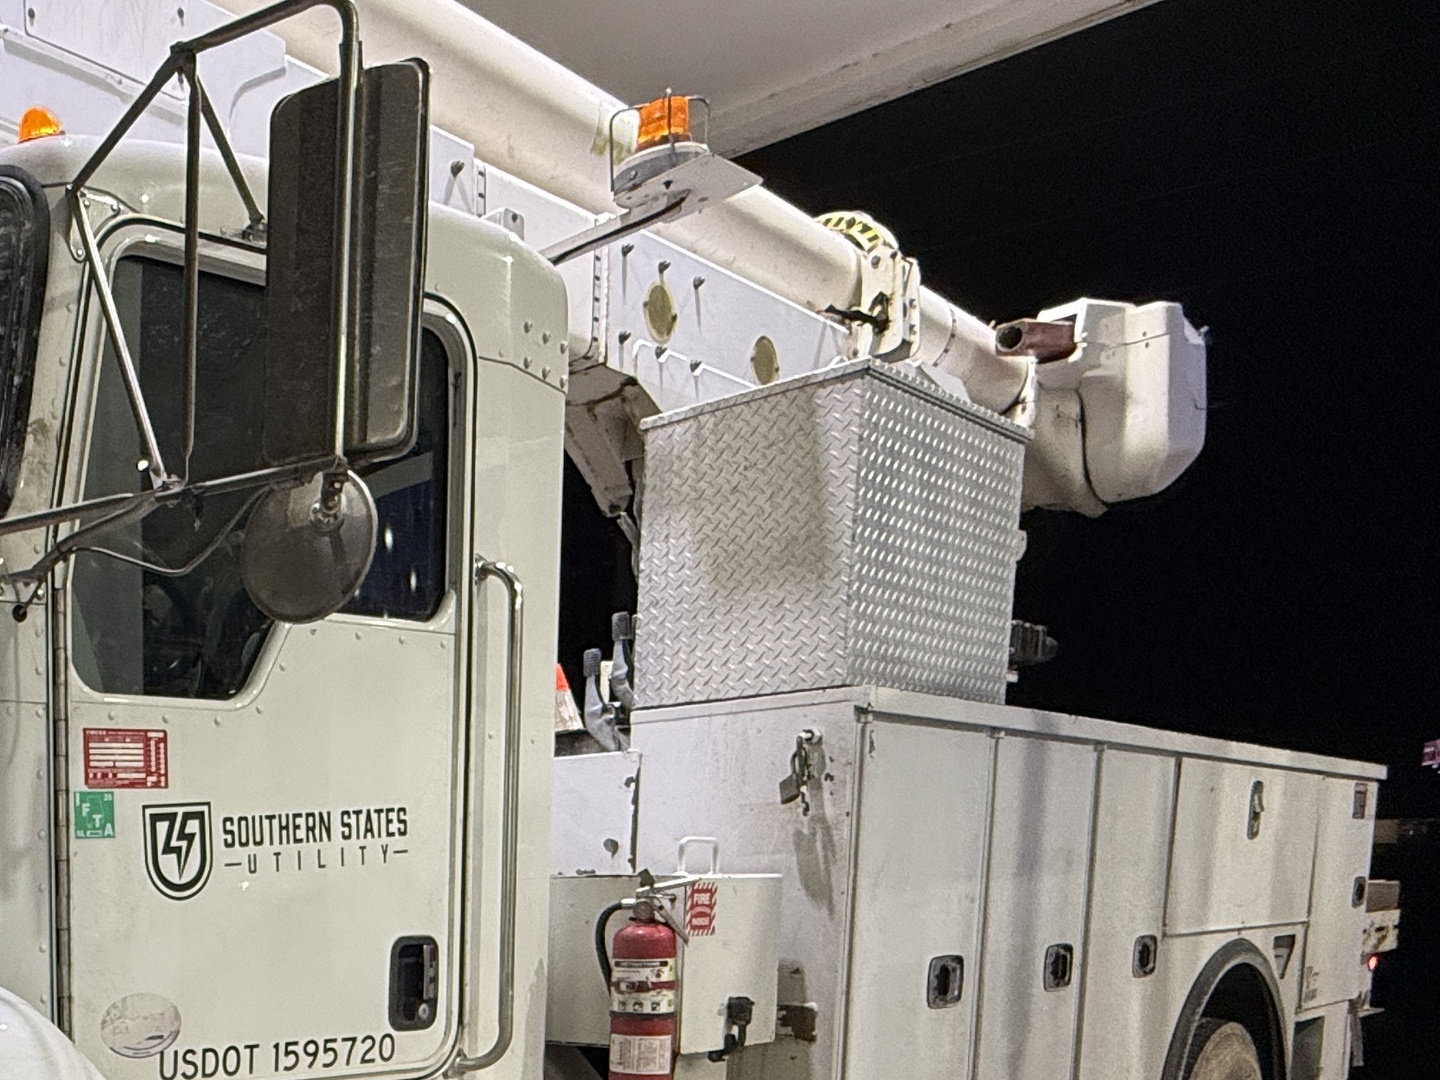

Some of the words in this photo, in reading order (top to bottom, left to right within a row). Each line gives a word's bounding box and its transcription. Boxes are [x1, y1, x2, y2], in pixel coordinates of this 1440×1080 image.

[222, 811, 332, 849] SOUTHERN
[340, 807, 408, 841] STATES
[693, 892, 711, 905] FIRE
[273, 1033, 396, 1073] 1595720
